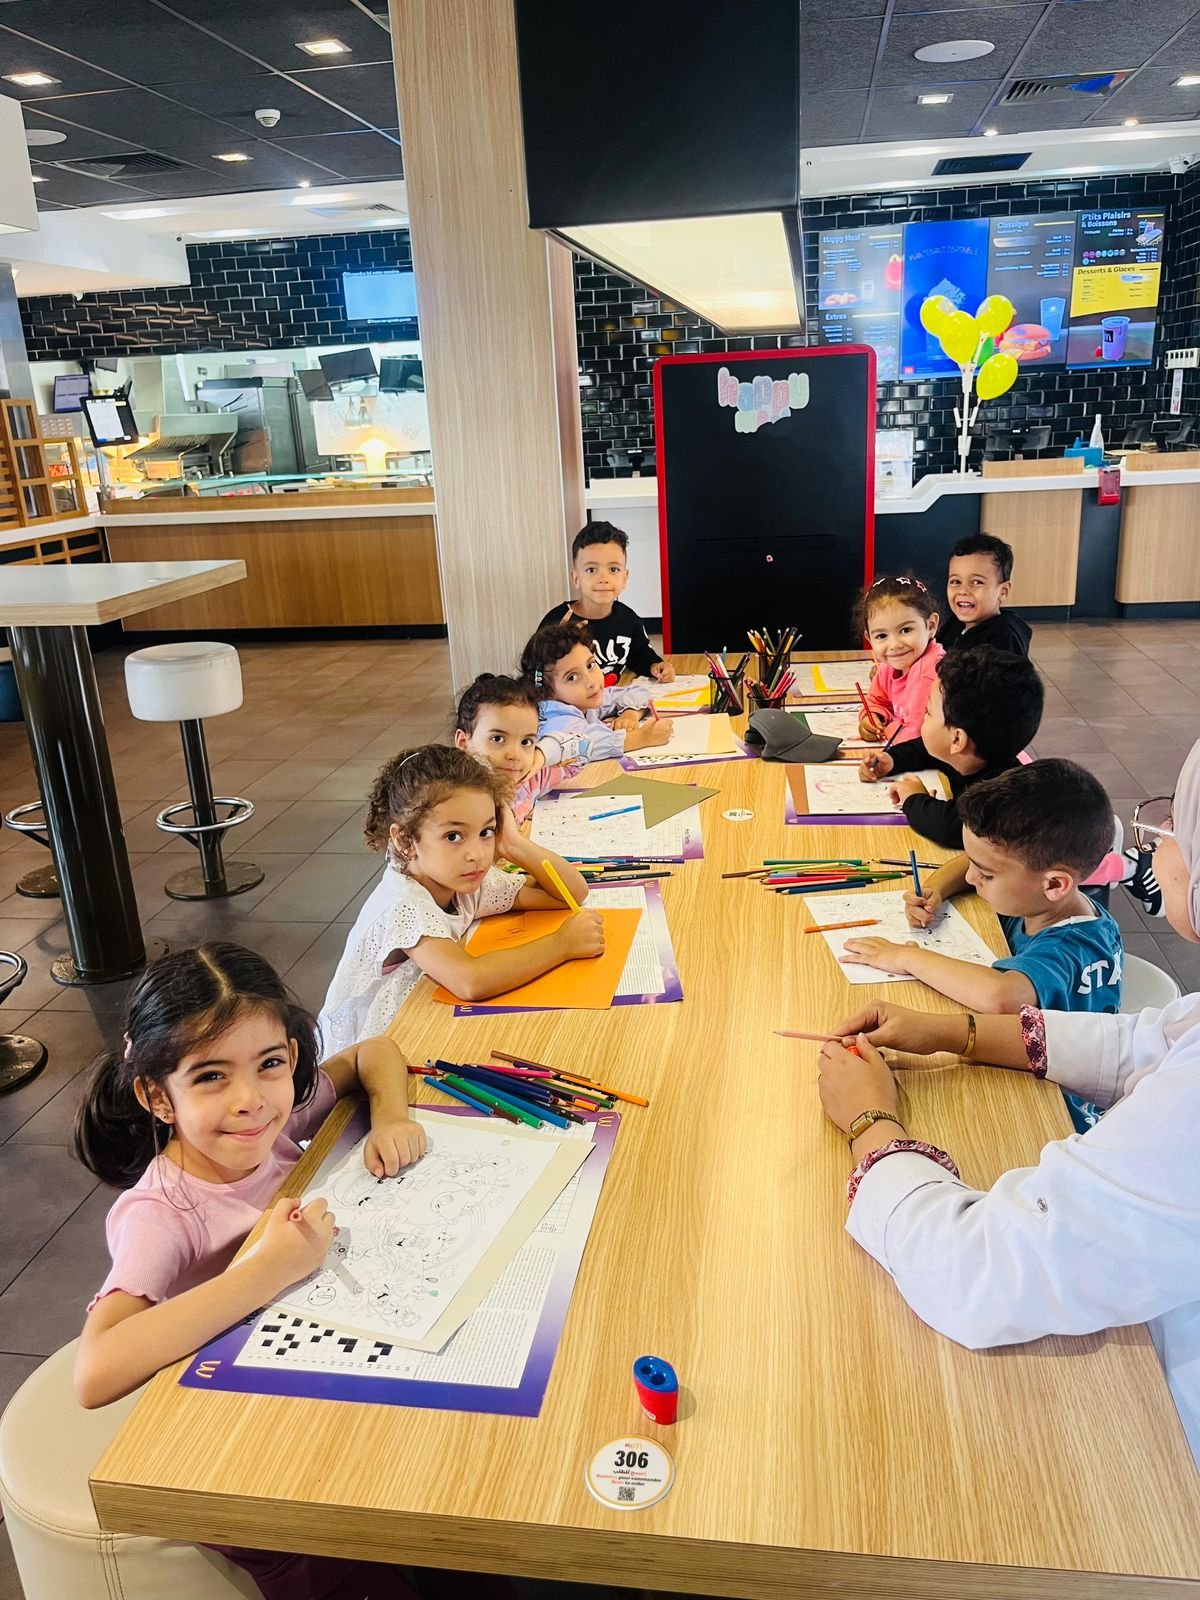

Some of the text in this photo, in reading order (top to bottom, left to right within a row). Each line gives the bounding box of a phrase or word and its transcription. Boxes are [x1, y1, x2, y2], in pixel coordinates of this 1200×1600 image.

[1102, 211, 1131, 220] Plaisirs
[1087, 220, 1118, 228] Boissons
[823, 236, 845, 244] Happy
[825, 313, 848, 321] Extras
[614, 1450, 649, 1468] 306
